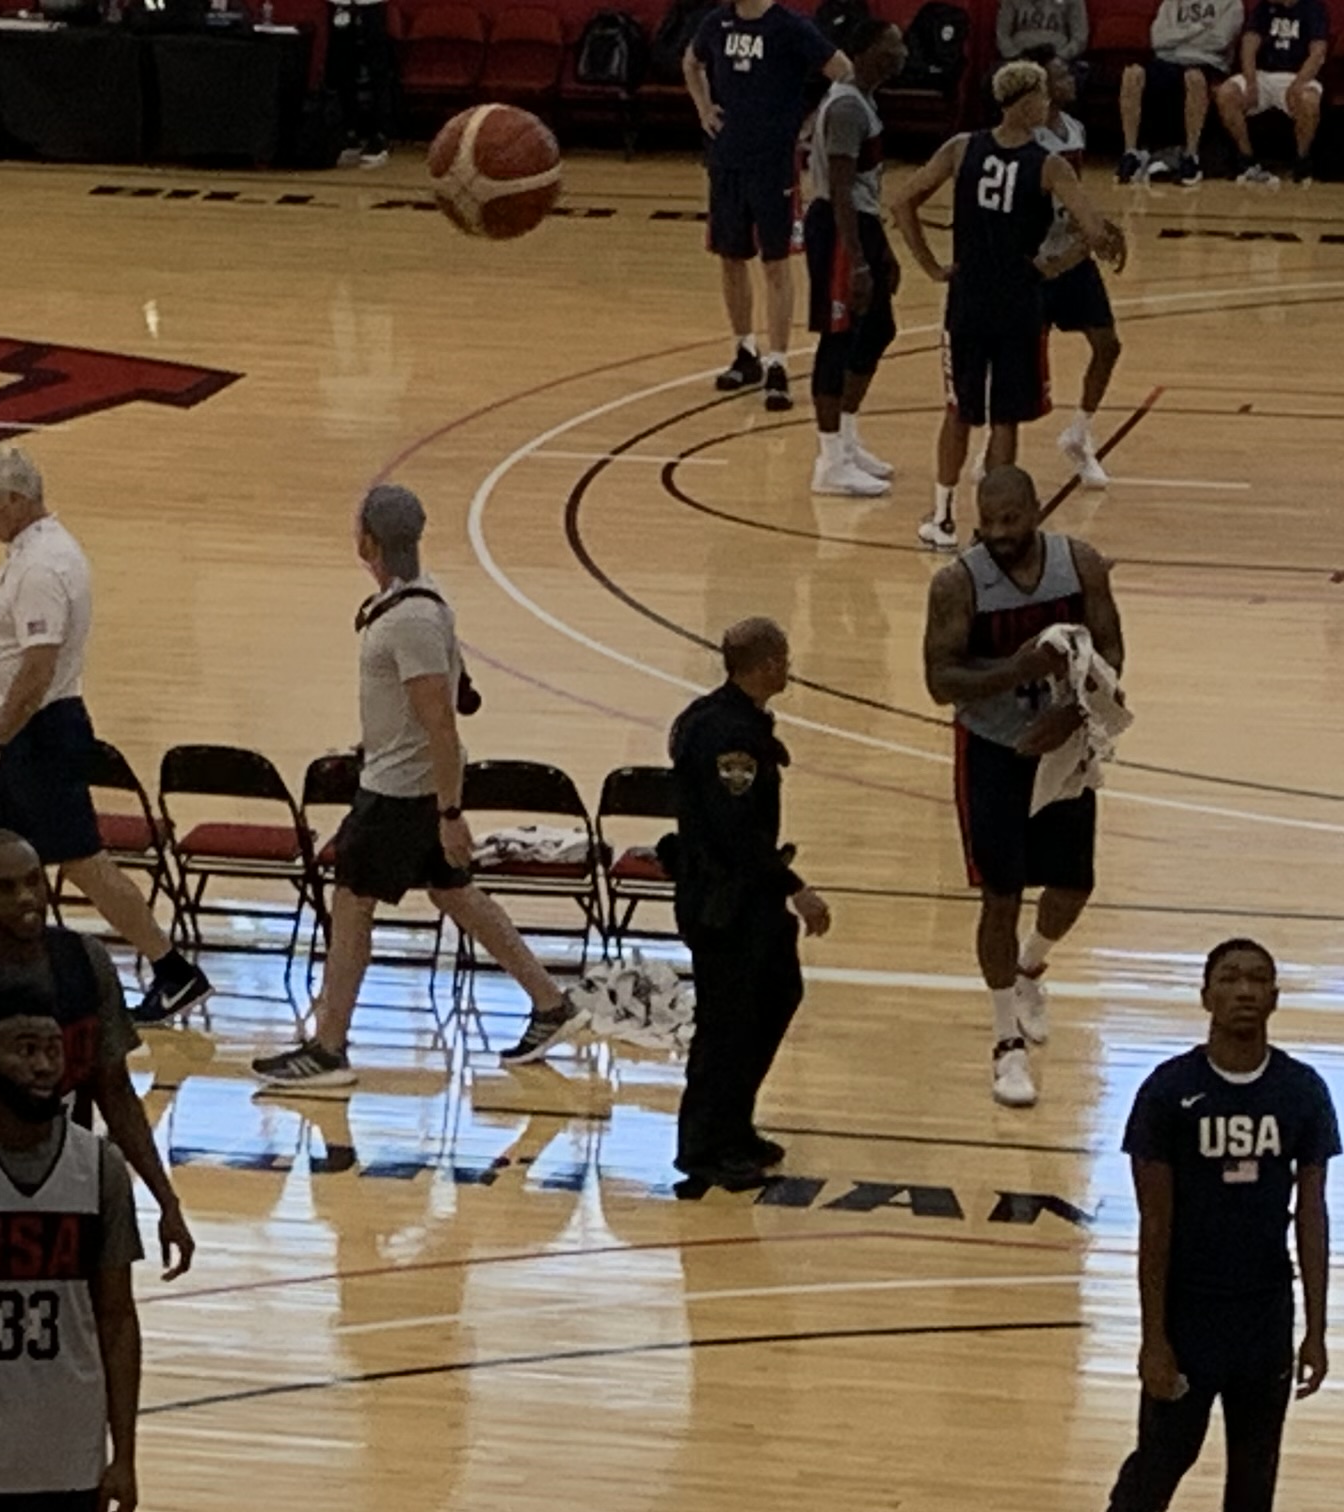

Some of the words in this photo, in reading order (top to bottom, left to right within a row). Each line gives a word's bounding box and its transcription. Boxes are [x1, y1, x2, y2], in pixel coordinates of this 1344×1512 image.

[1178, 3, 1216, 24] USA
[1270, 16, 1301, 40] USA
[724, 32, 764, 60] USA
[977, 154, 1019, 214] 21
[1199, 1115, 1282, 1159] USA
